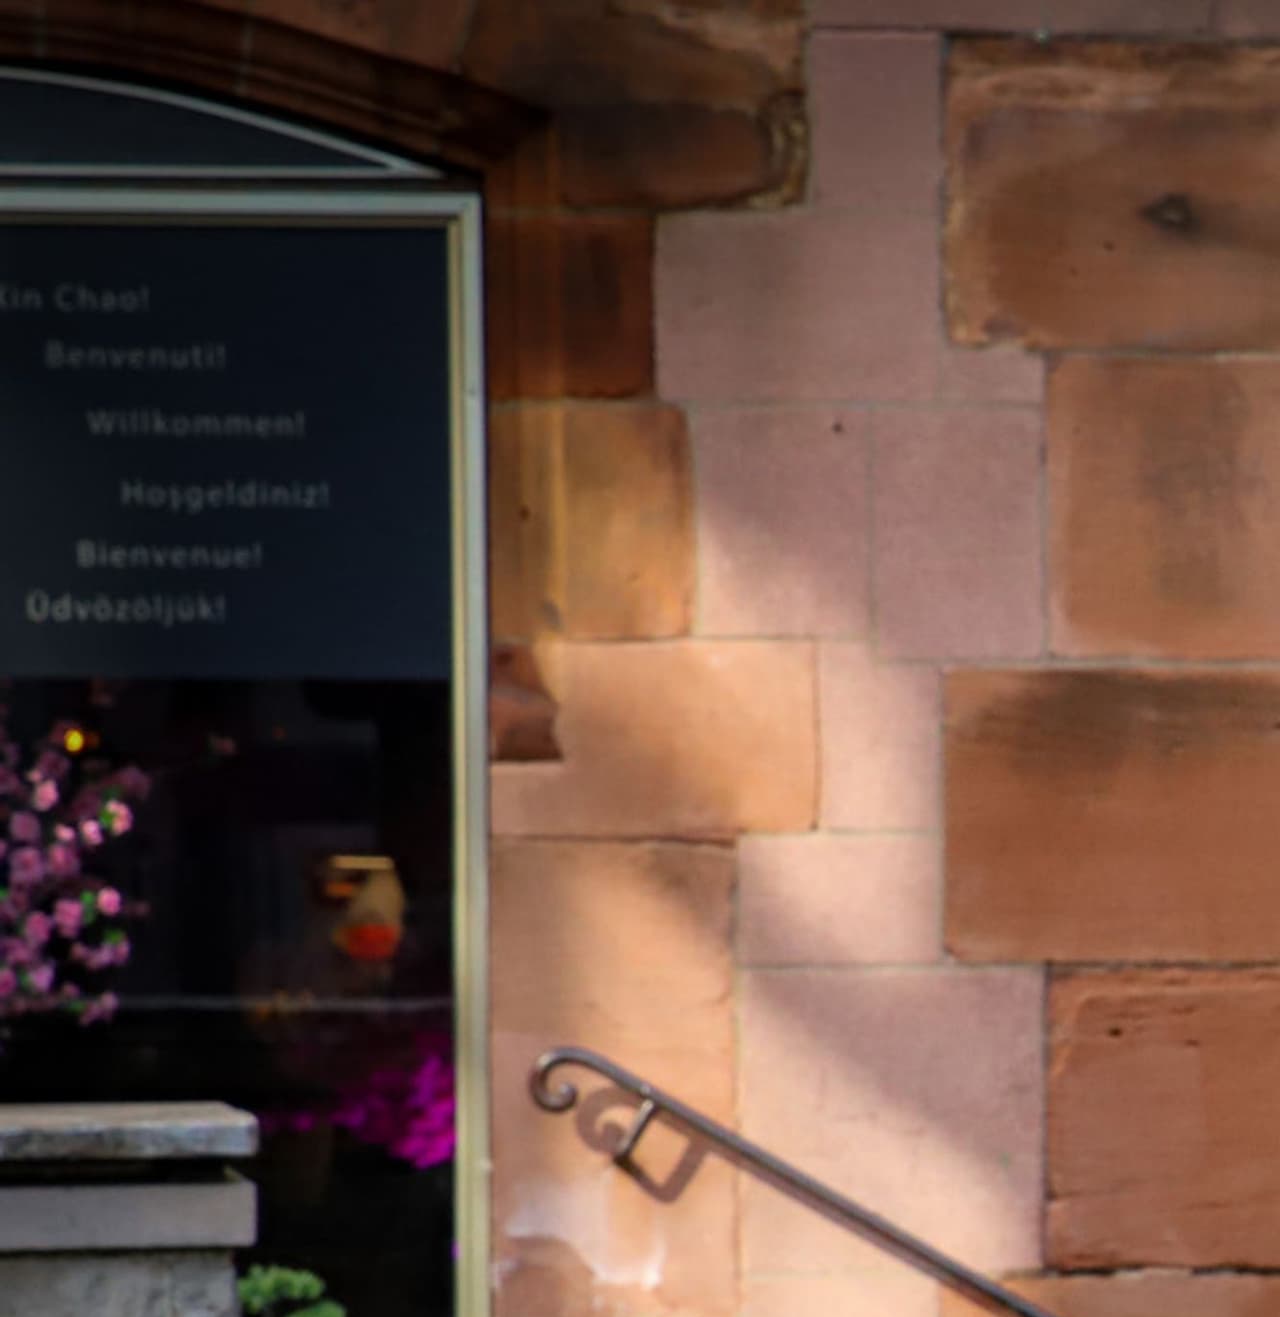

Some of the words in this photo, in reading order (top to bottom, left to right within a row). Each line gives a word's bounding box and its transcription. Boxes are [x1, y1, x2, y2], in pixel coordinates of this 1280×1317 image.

[45, 340, 226, 368] Benvenuti!
[86, 411, 305, 437] Willkommen!
[75, 539, 263, 568] Bienvenue!
